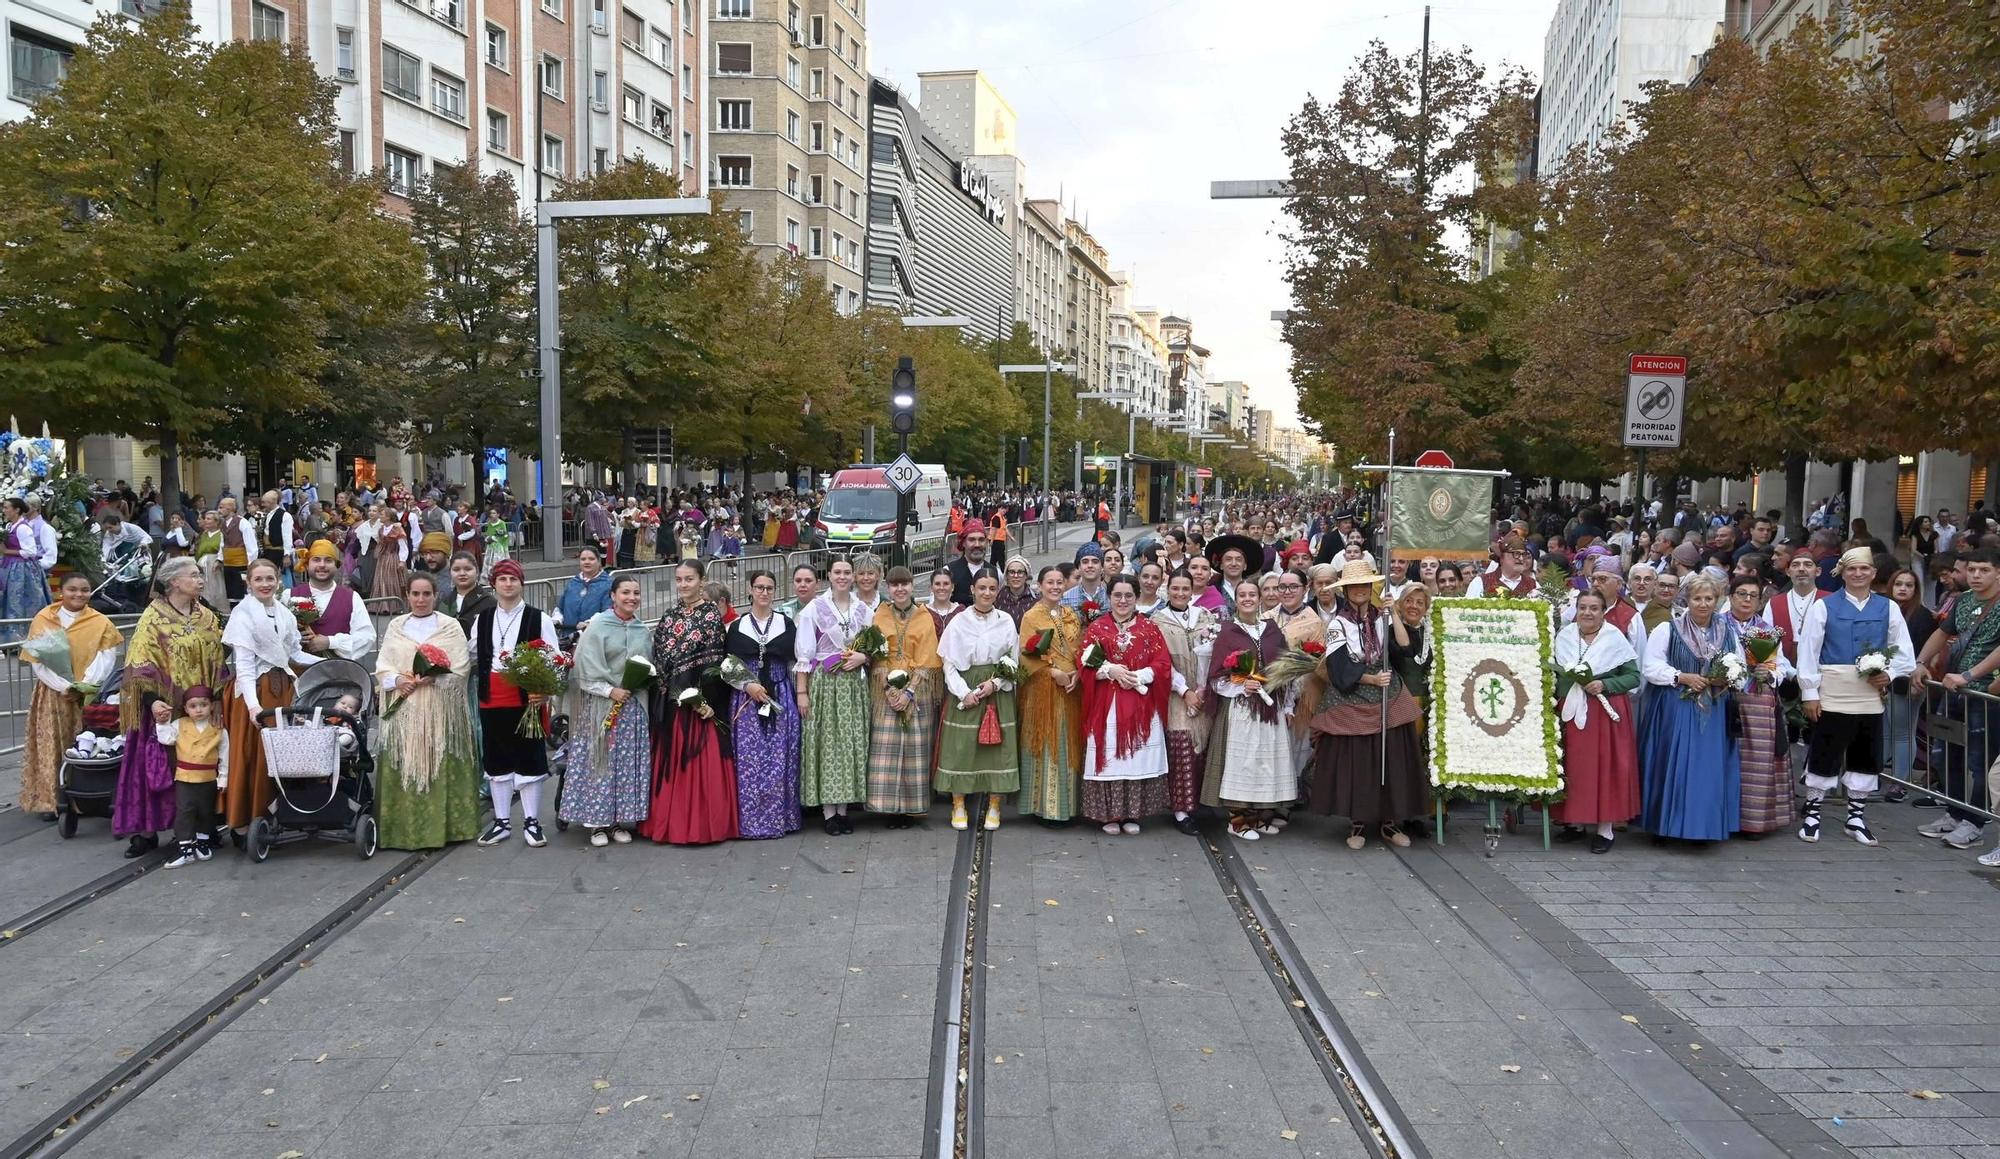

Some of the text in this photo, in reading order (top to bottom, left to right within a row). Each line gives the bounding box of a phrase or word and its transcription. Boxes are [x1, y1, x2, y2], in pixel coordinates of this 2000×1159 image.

[1636, 361, 1680, 370] ATENCIÓN
[1642, 391, 1670, 410] 20
[1631, 422, 1676, 431] PRIORIDAD
[1631, 433, 1674, 442] PEATONAL
[894, 466, 913, 481] 30
